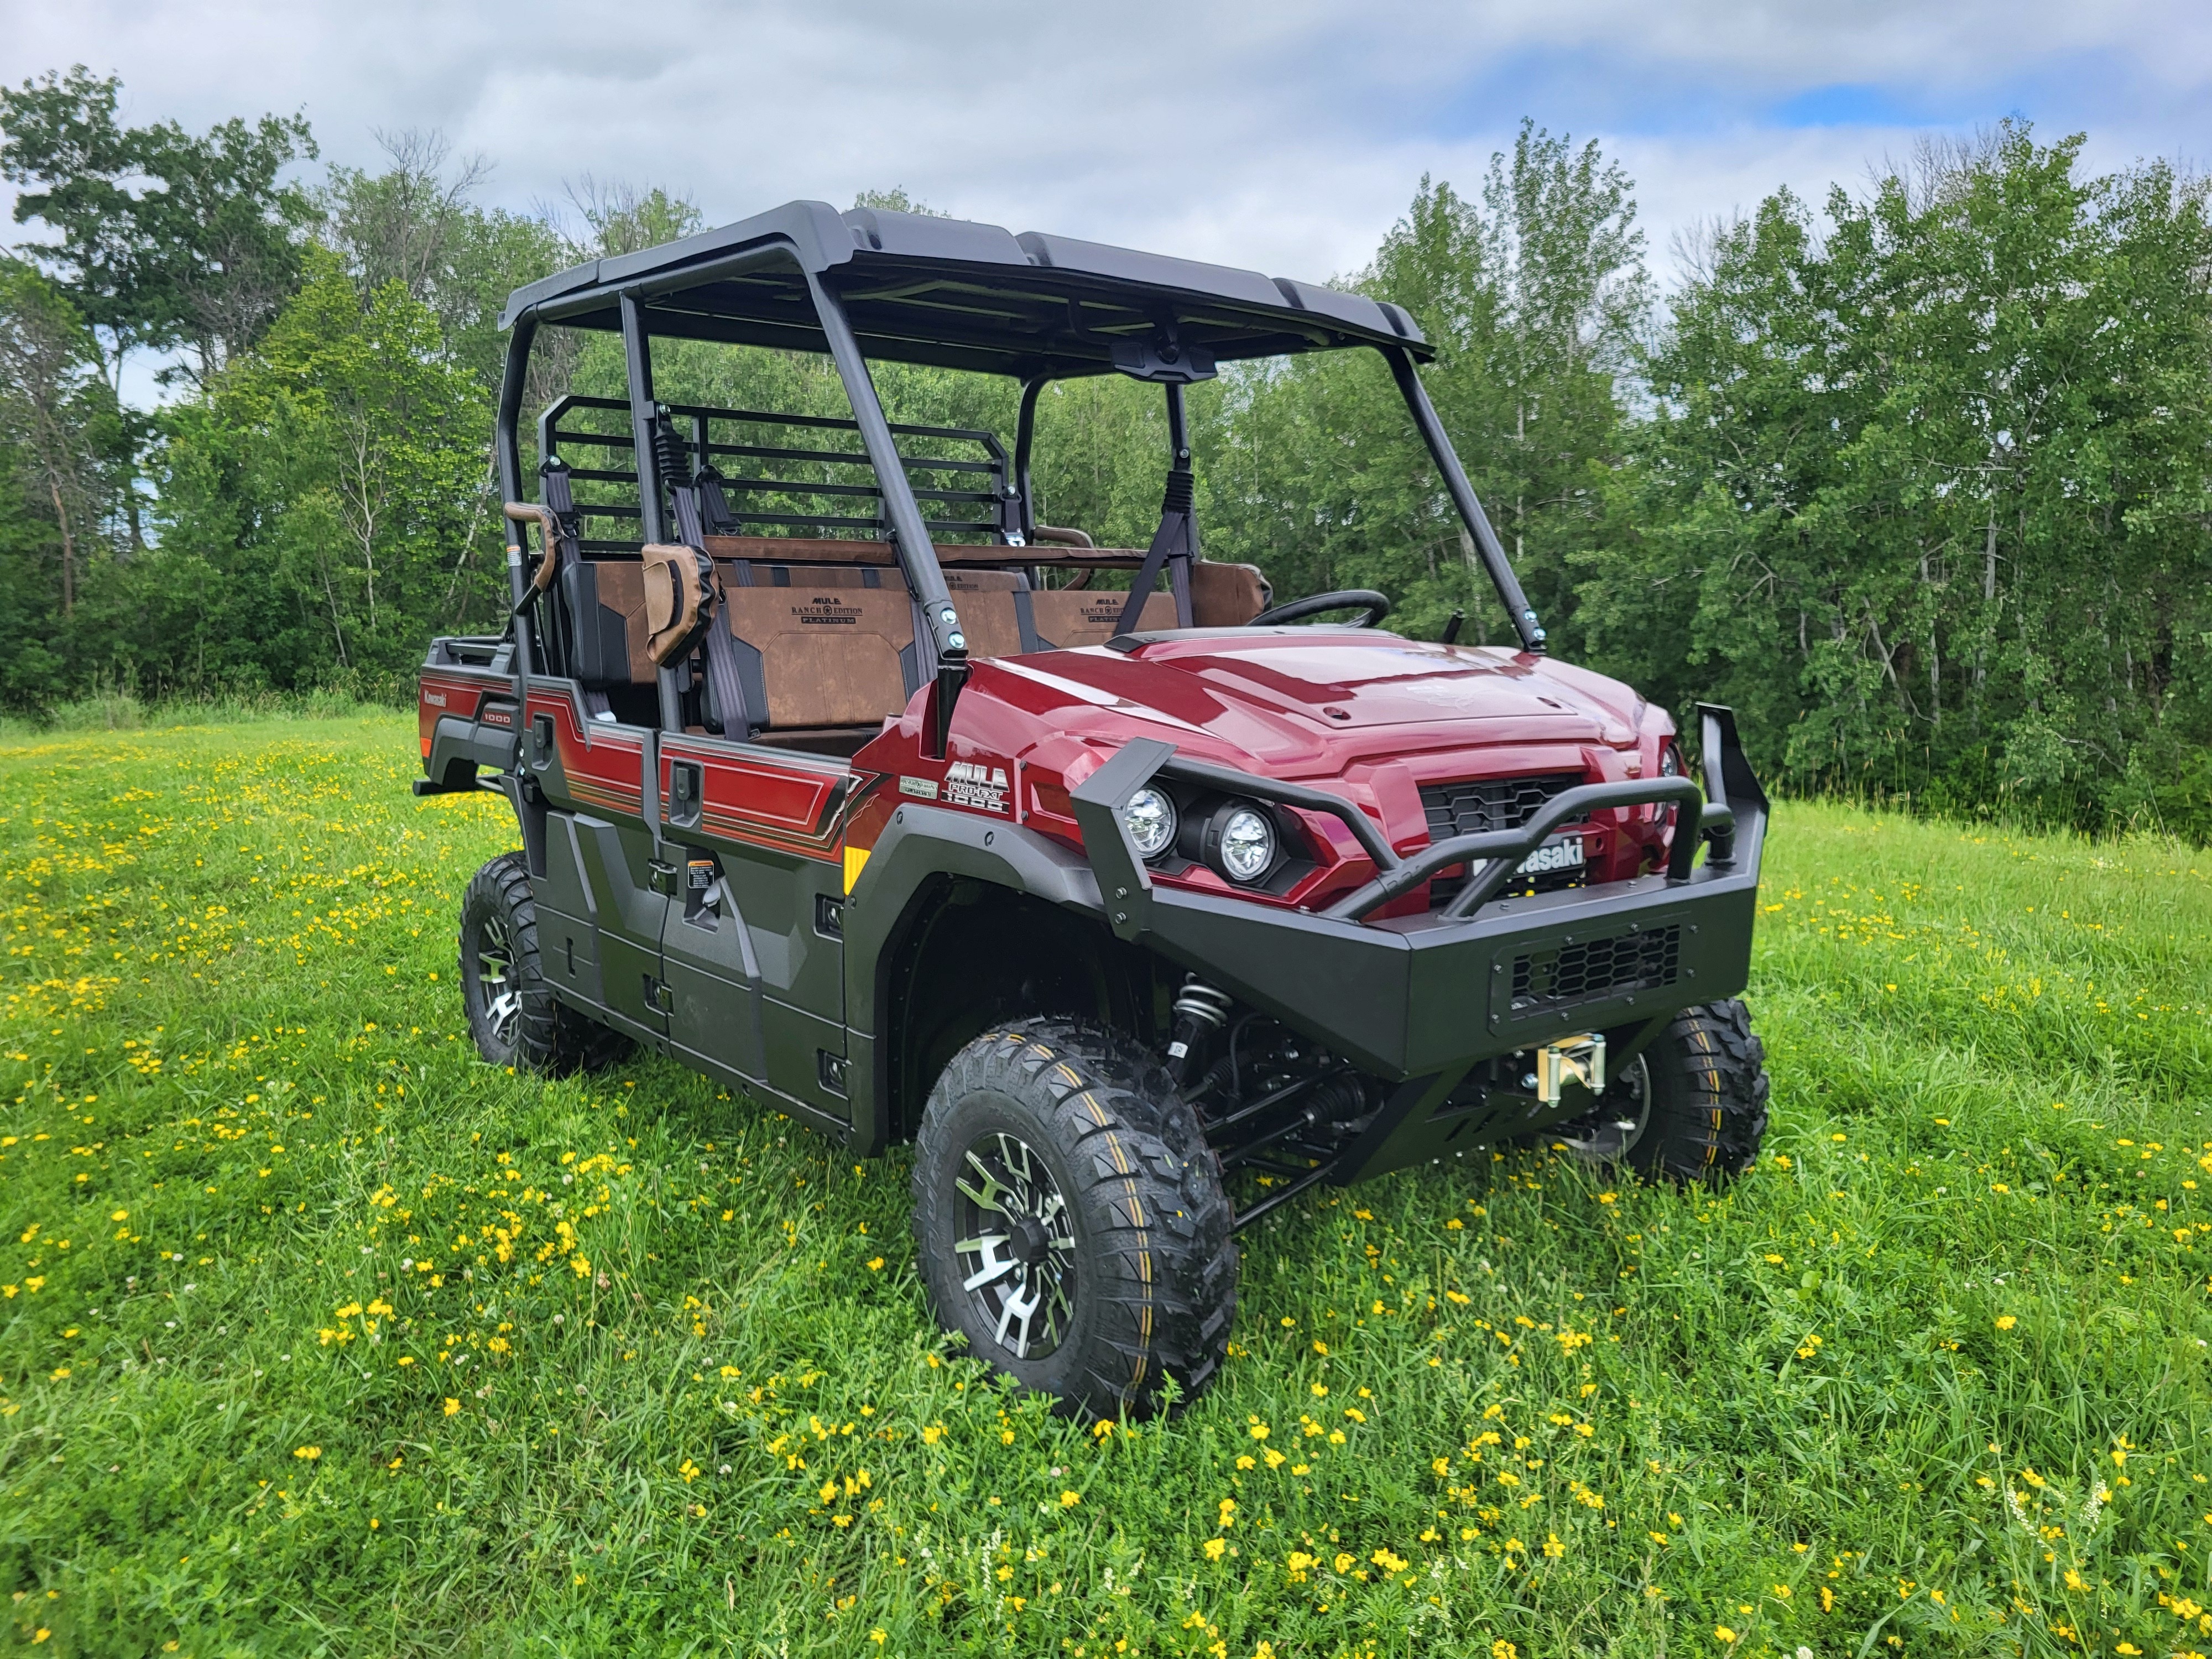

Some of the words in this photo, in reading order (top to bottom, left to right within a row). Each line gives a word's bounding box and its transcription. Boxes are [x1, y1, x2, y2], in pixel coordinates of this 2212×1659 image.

[484, 713, 510, 723] 1000
[944, 761, 1010, 792] MULE
[947, 793, 1003, 811] 1000
